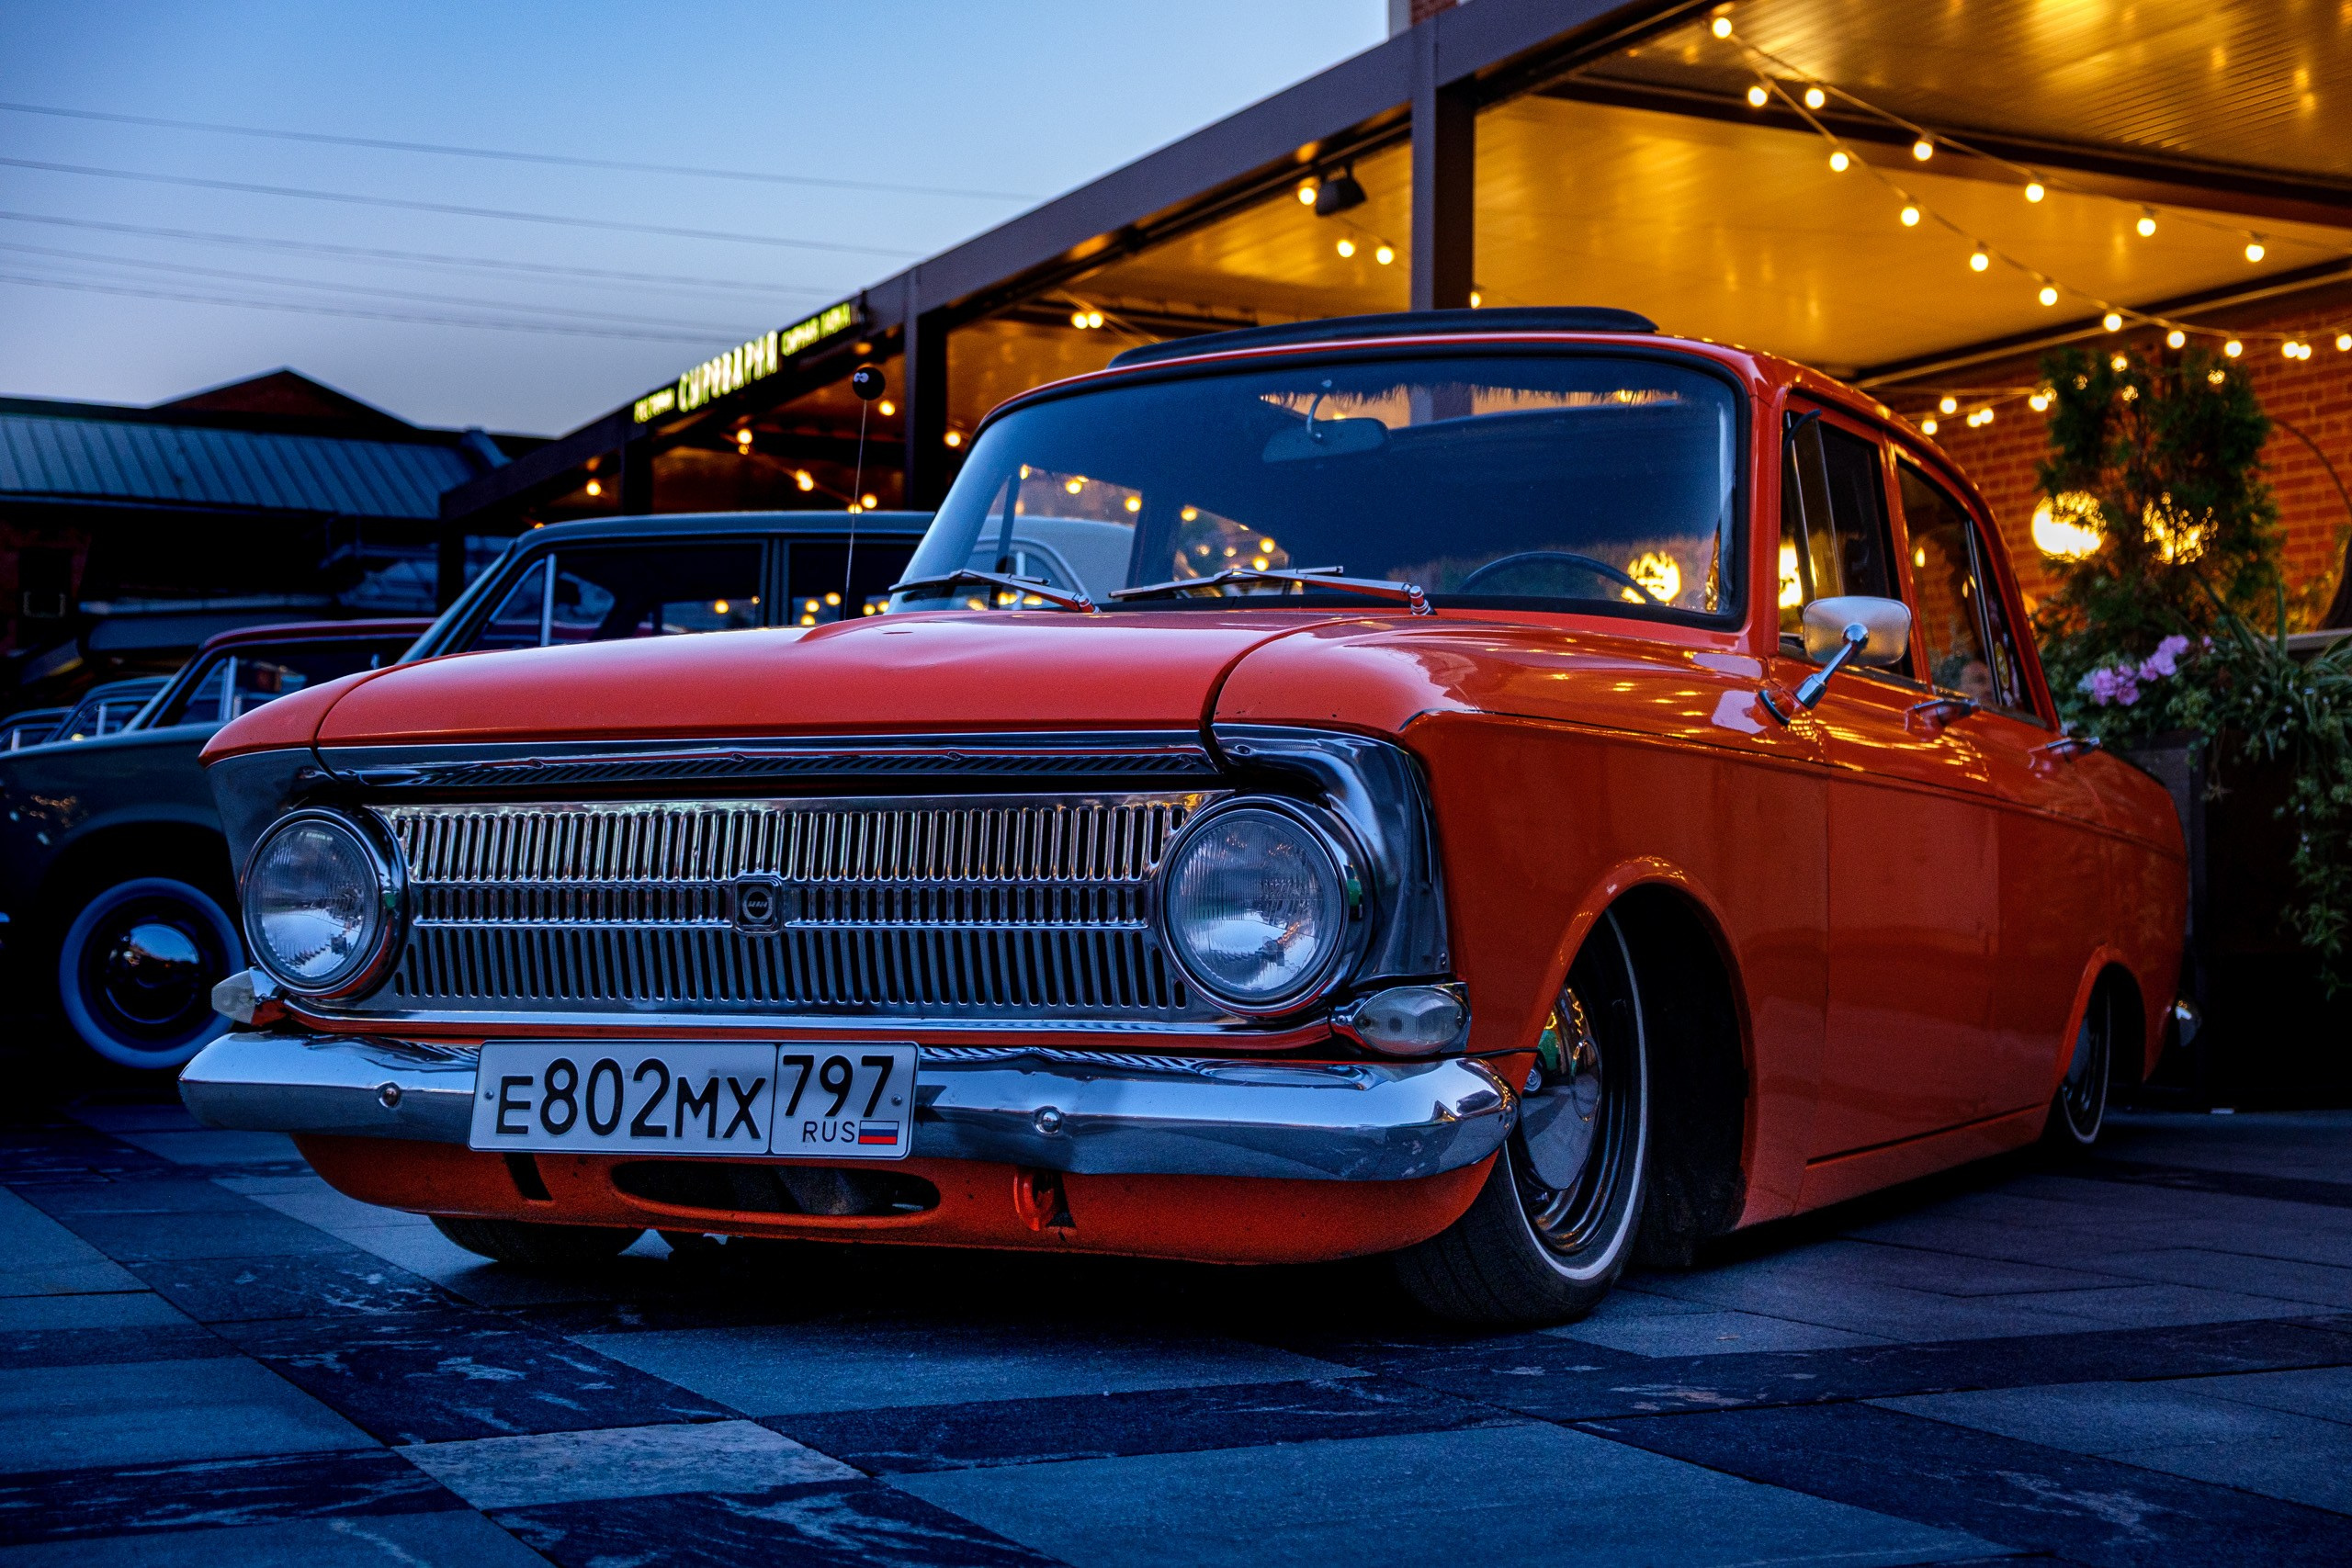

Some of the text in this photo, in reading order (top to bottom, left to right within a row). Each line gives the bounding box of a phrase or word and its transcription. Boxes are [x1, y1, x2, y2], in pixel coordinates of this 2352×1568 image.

[495, 1054, 896, 1140] E802MX 797
[802, 1120, 855, 1144] RUS
